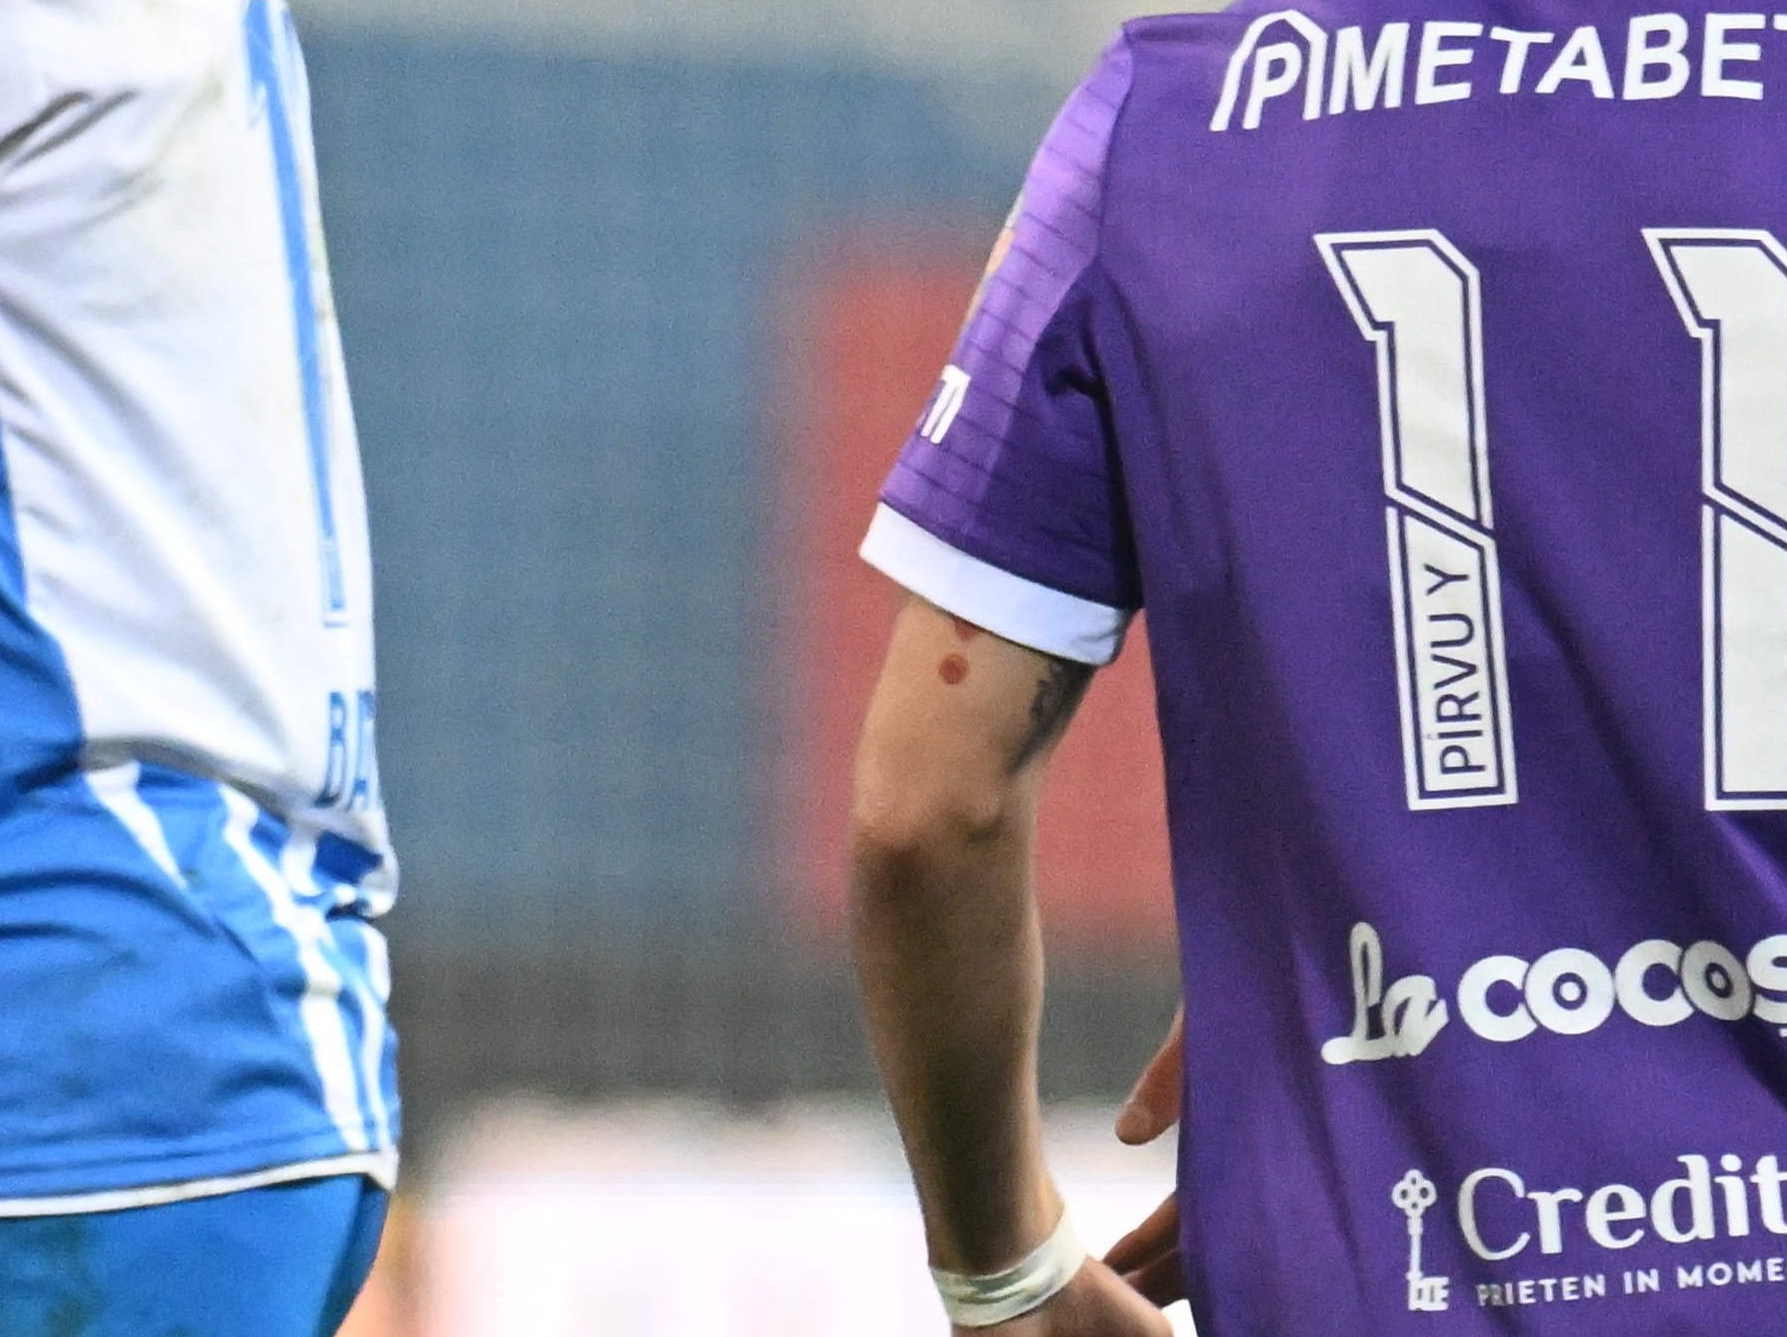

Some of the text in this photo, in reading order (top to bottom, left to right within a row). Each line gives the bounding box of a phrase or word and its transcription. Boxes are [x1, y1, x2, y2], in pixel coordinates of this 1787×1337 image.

[1322, 921, 1448, 1065] La
[1476, 1274, 1606, 1307] PRIETEN
[1623, 1269, 1661, 1298] IN
